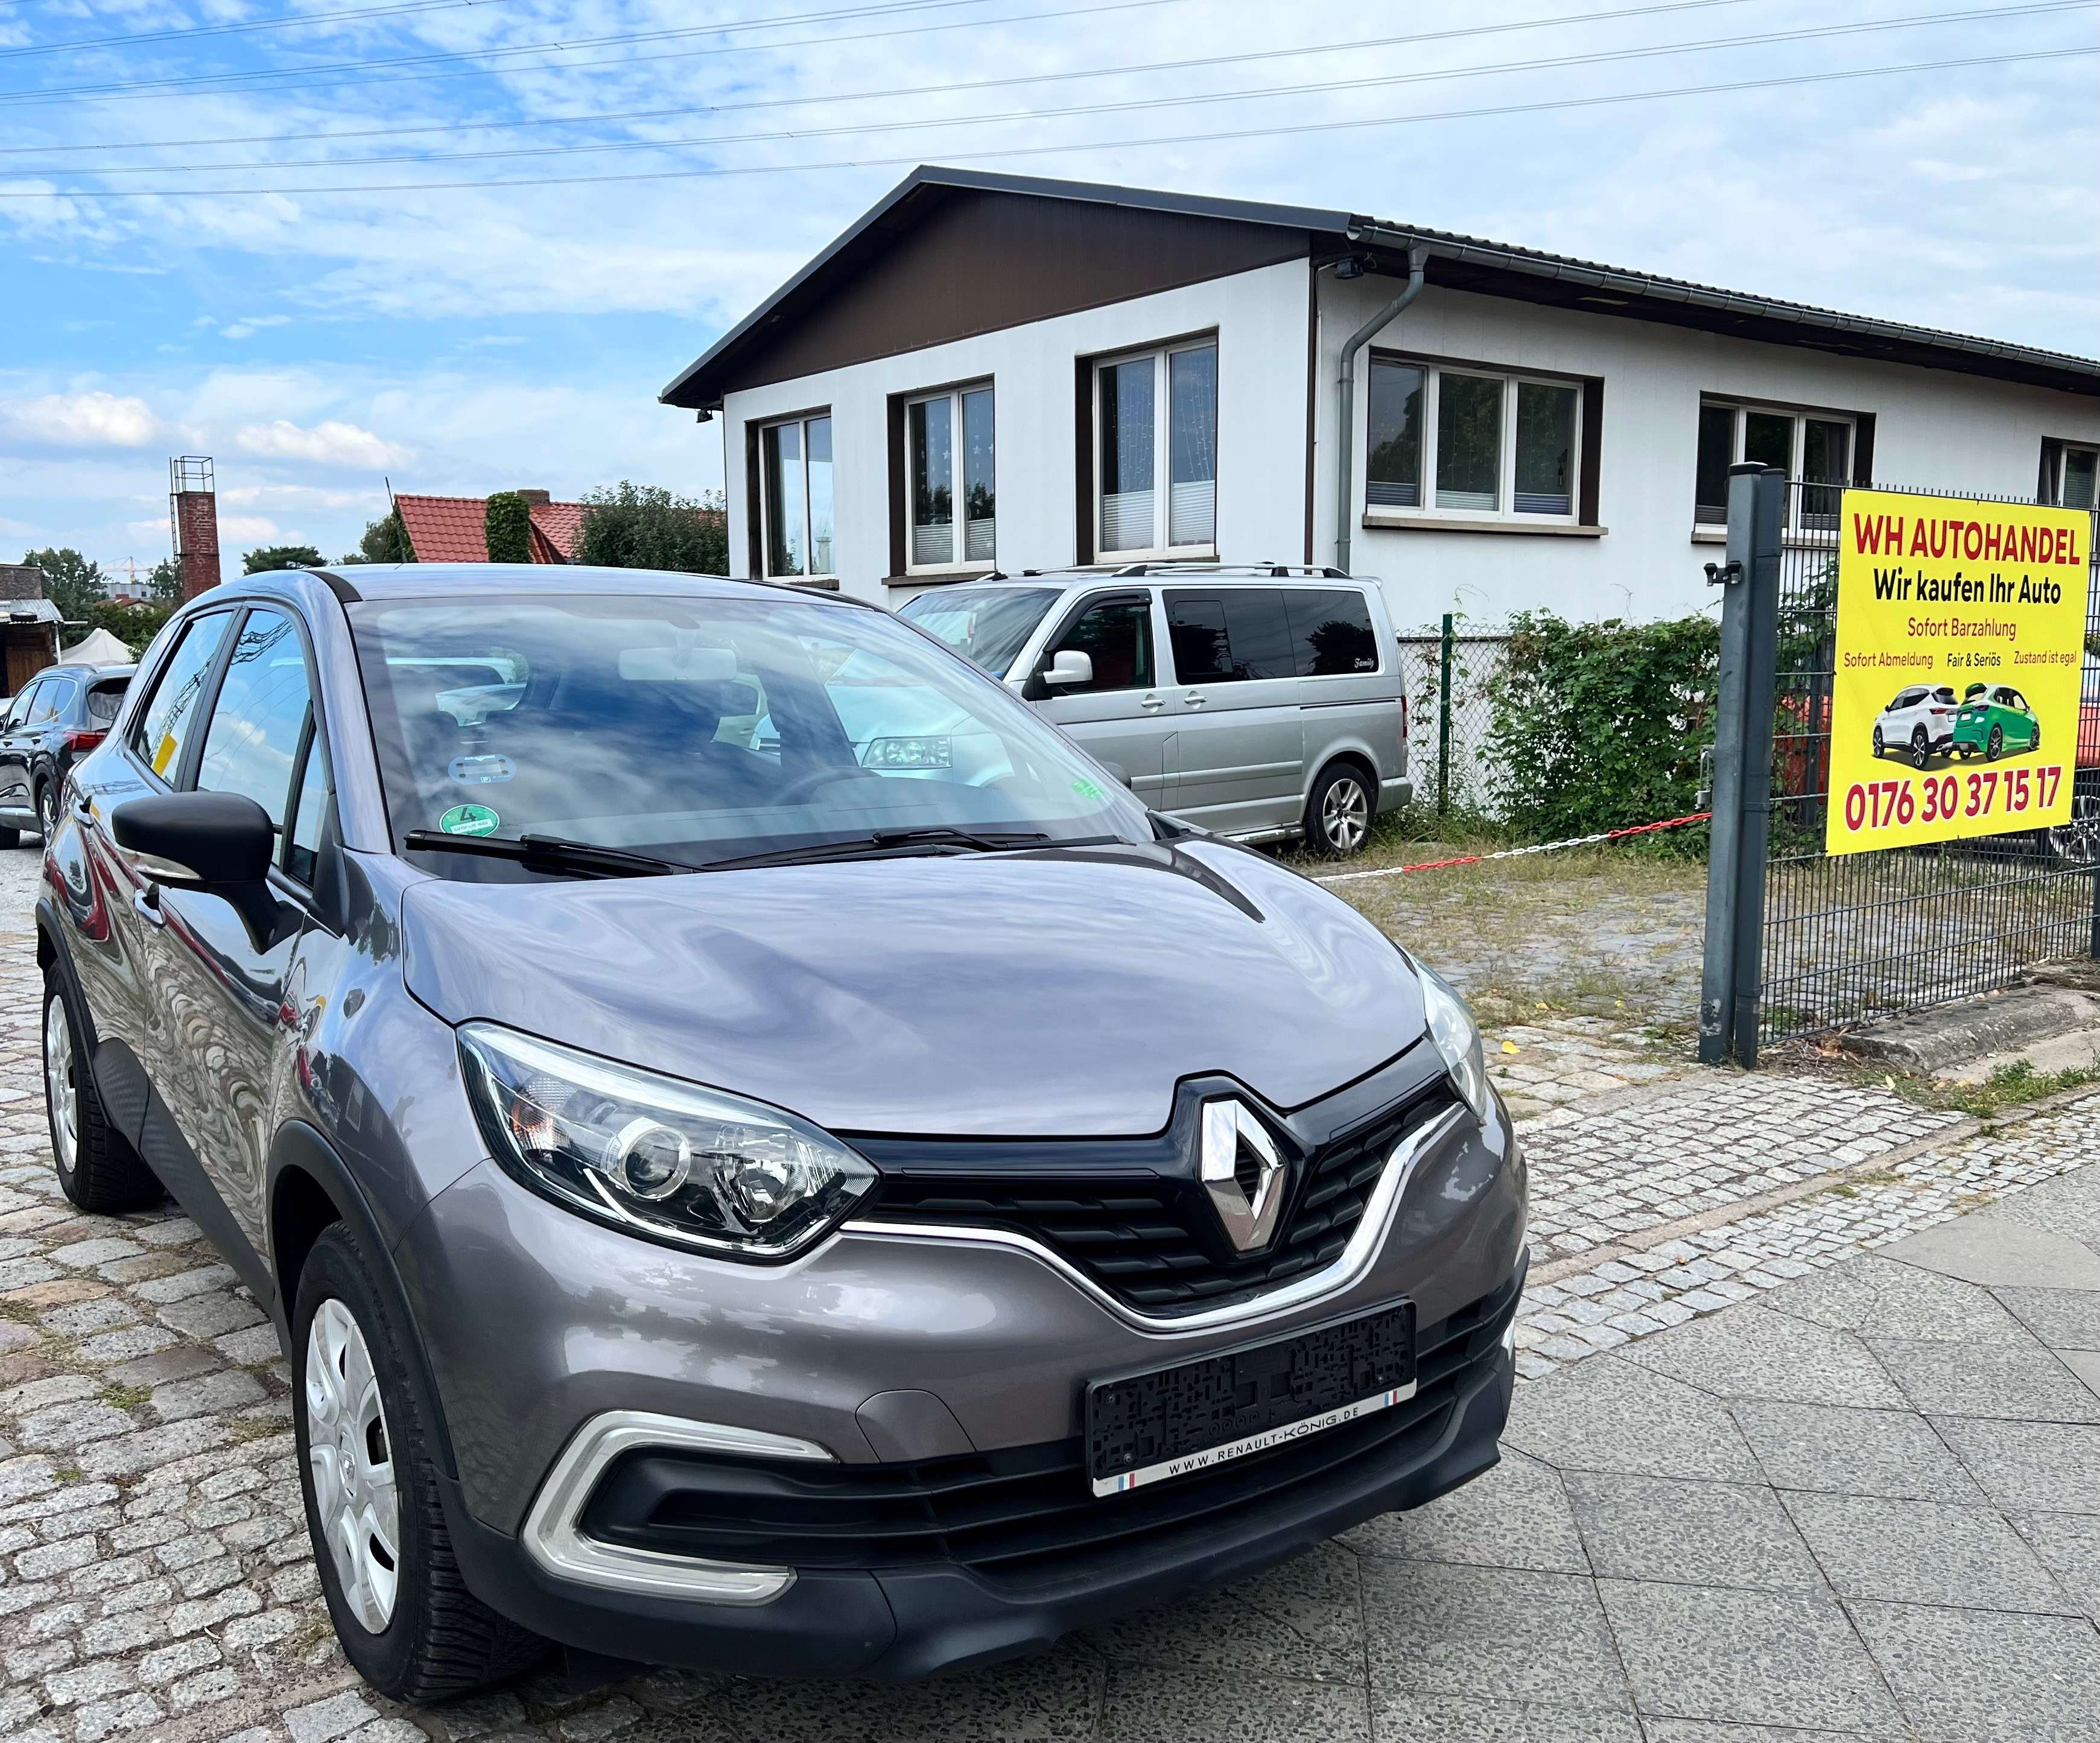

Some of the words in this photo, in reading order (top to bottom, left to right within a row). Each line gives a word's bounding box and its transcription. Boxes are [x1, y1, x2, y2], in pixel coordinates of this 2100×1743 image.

[1854, 513, 1903, 556] WH
[1910, 518, 2080, 565] AUTOHANDEL
[1873, 566, 1911, 600] Wir
[1917, 570, 1984, 602] kaufen
[1990, 573, 2015, 603] Ihr
[2018, 574, 2061, 604] Auto
[1908, 617, 1948, 637] Sofort
[1952, 618, 2017, 641] Barzahlung
[1844, 652, 1877, 667] Sofort
[1879, 652, 1933, 670] Abmeldung
[1947, 652, 1964, 667] Fair
[1966, 652, 1972, 667] &
[1974, 652, 2001, 667] Seriös
[2014, 650, 2048, 664] Zustand
[2048, 649, 2058, 663] ist
[2060, 650, 2077, 667] egal
[1845, 779, 1914, 831] 0176
[1921, 775, 1958, 822] 30
[1965, 772, 1998, 817] 37
[2003, 769, 2029, 812] 15
[2036, 766, 2062, 808] 17
[460, 807, 477, 821] 4
